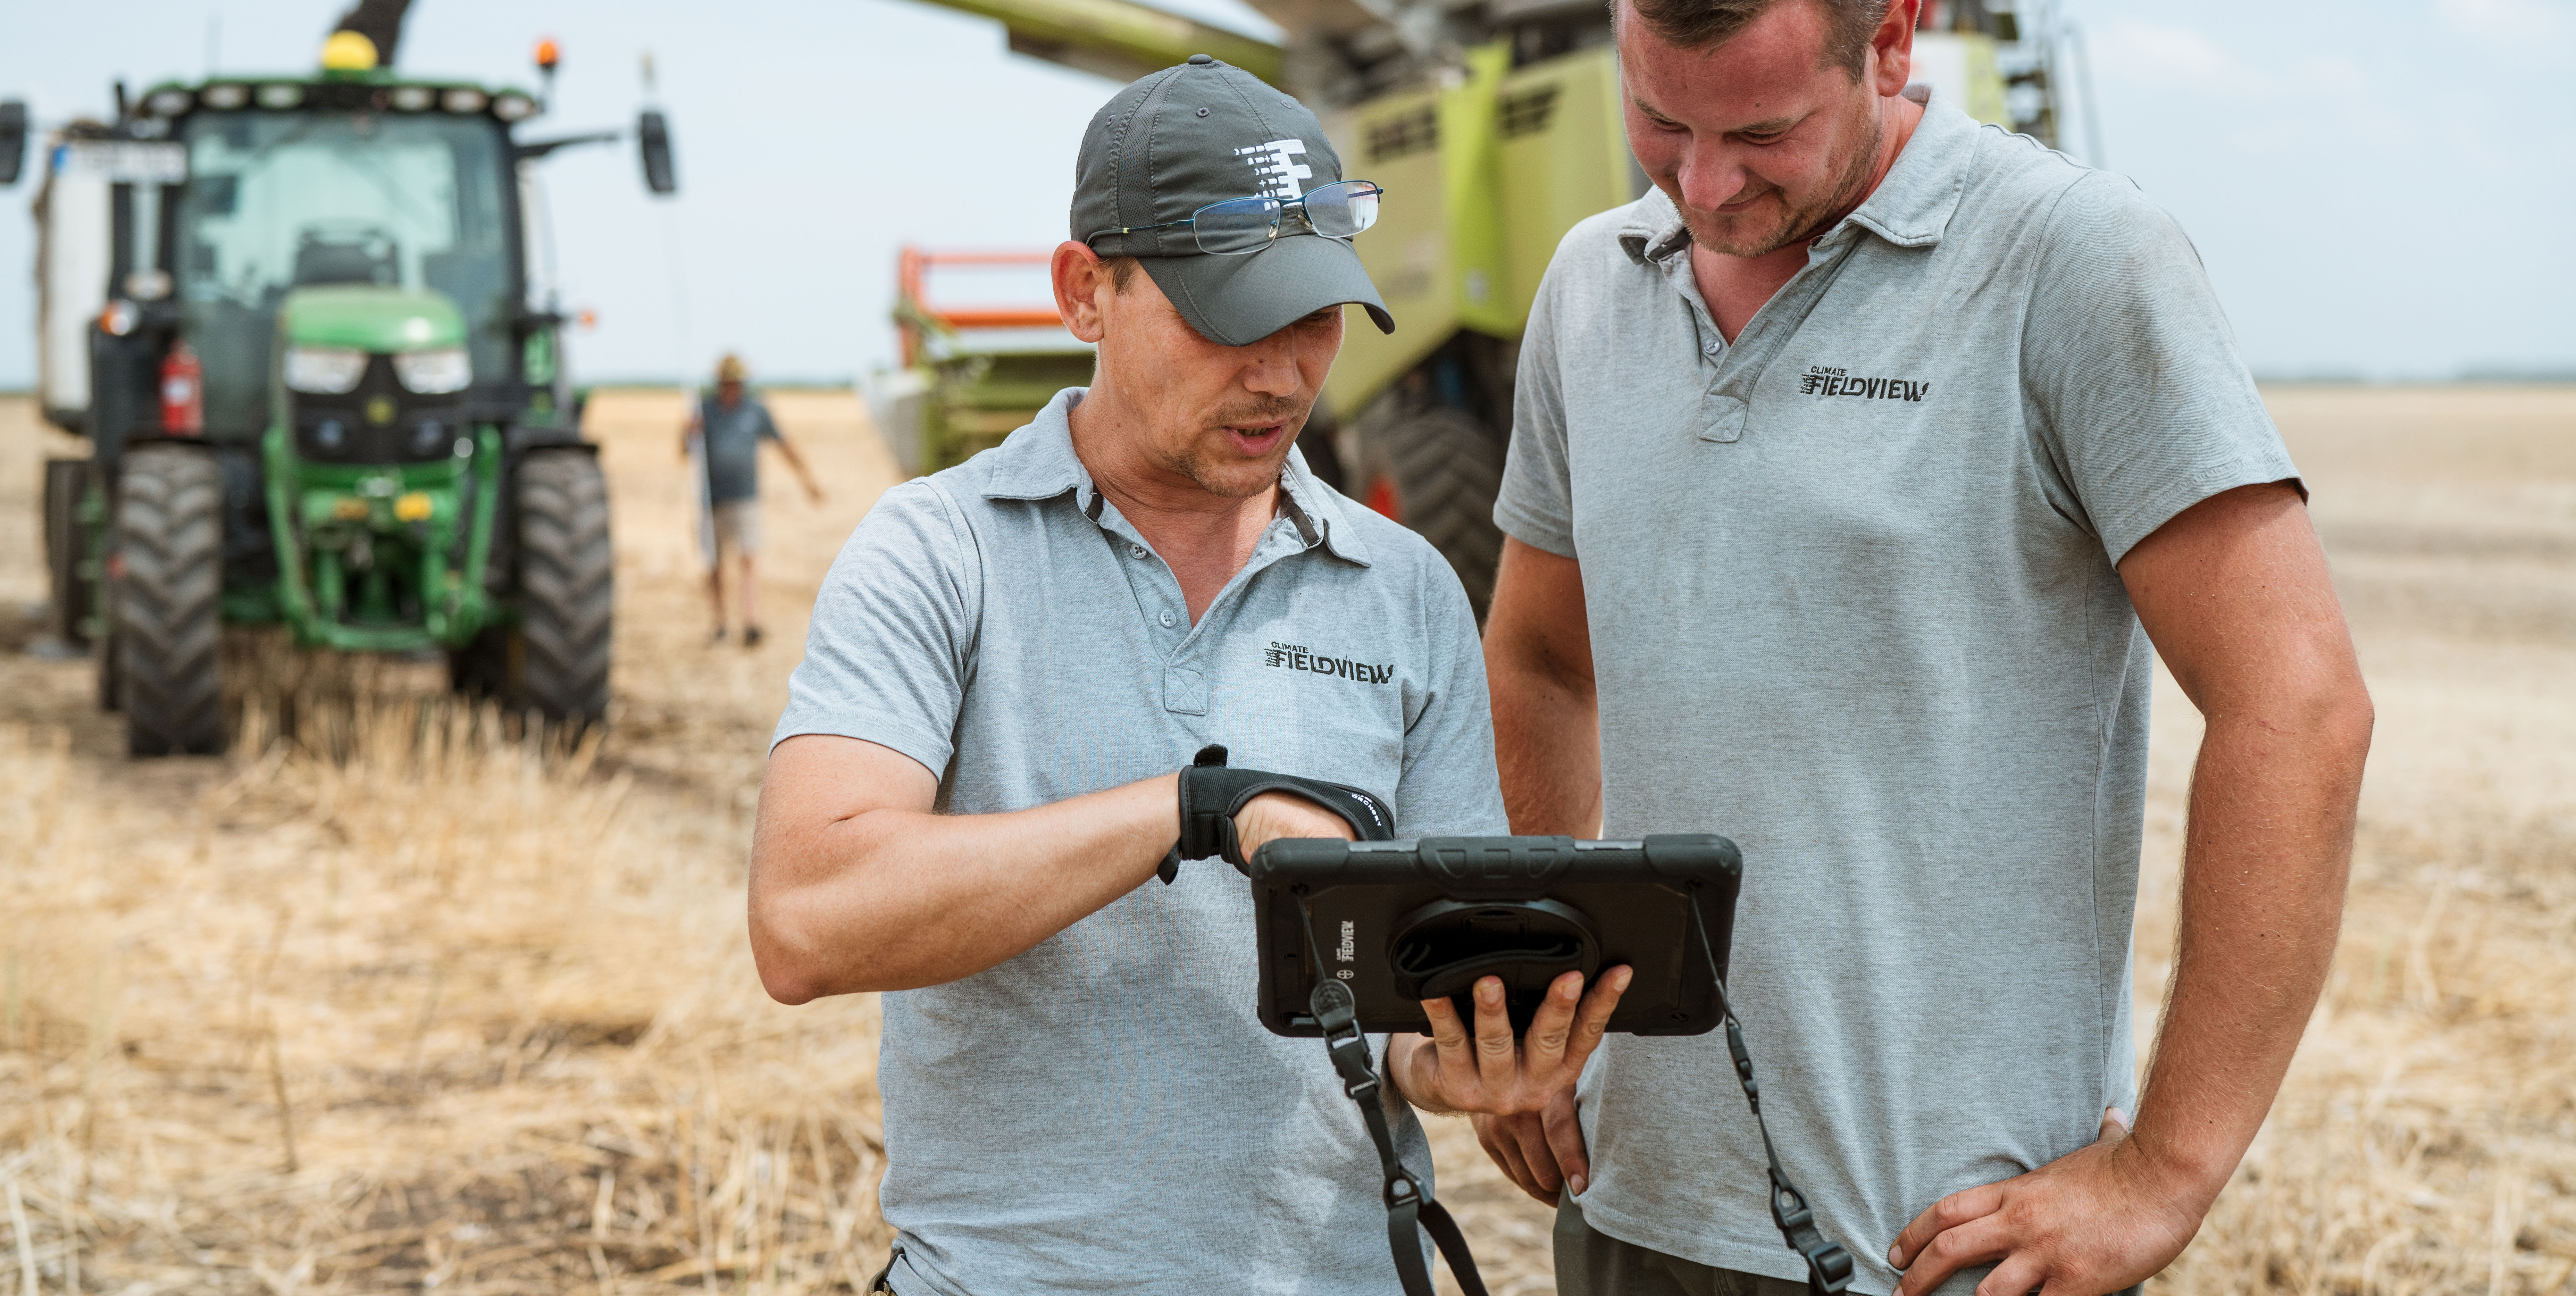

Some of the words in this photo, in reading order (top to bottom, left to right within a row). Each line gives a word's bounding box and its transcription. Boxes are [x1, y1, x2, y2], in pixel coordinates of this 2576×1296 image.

[1811, 366, 1847, 376] CLIMATE
[1801, 374, 1929, 402] FIELDVIEW
[1271, 641, 1309, 654] CLIMATE
[1264, 648, 1394, 684] FIELDVIEW
[1341, 920, 1354, 962] FIELDVIEW
